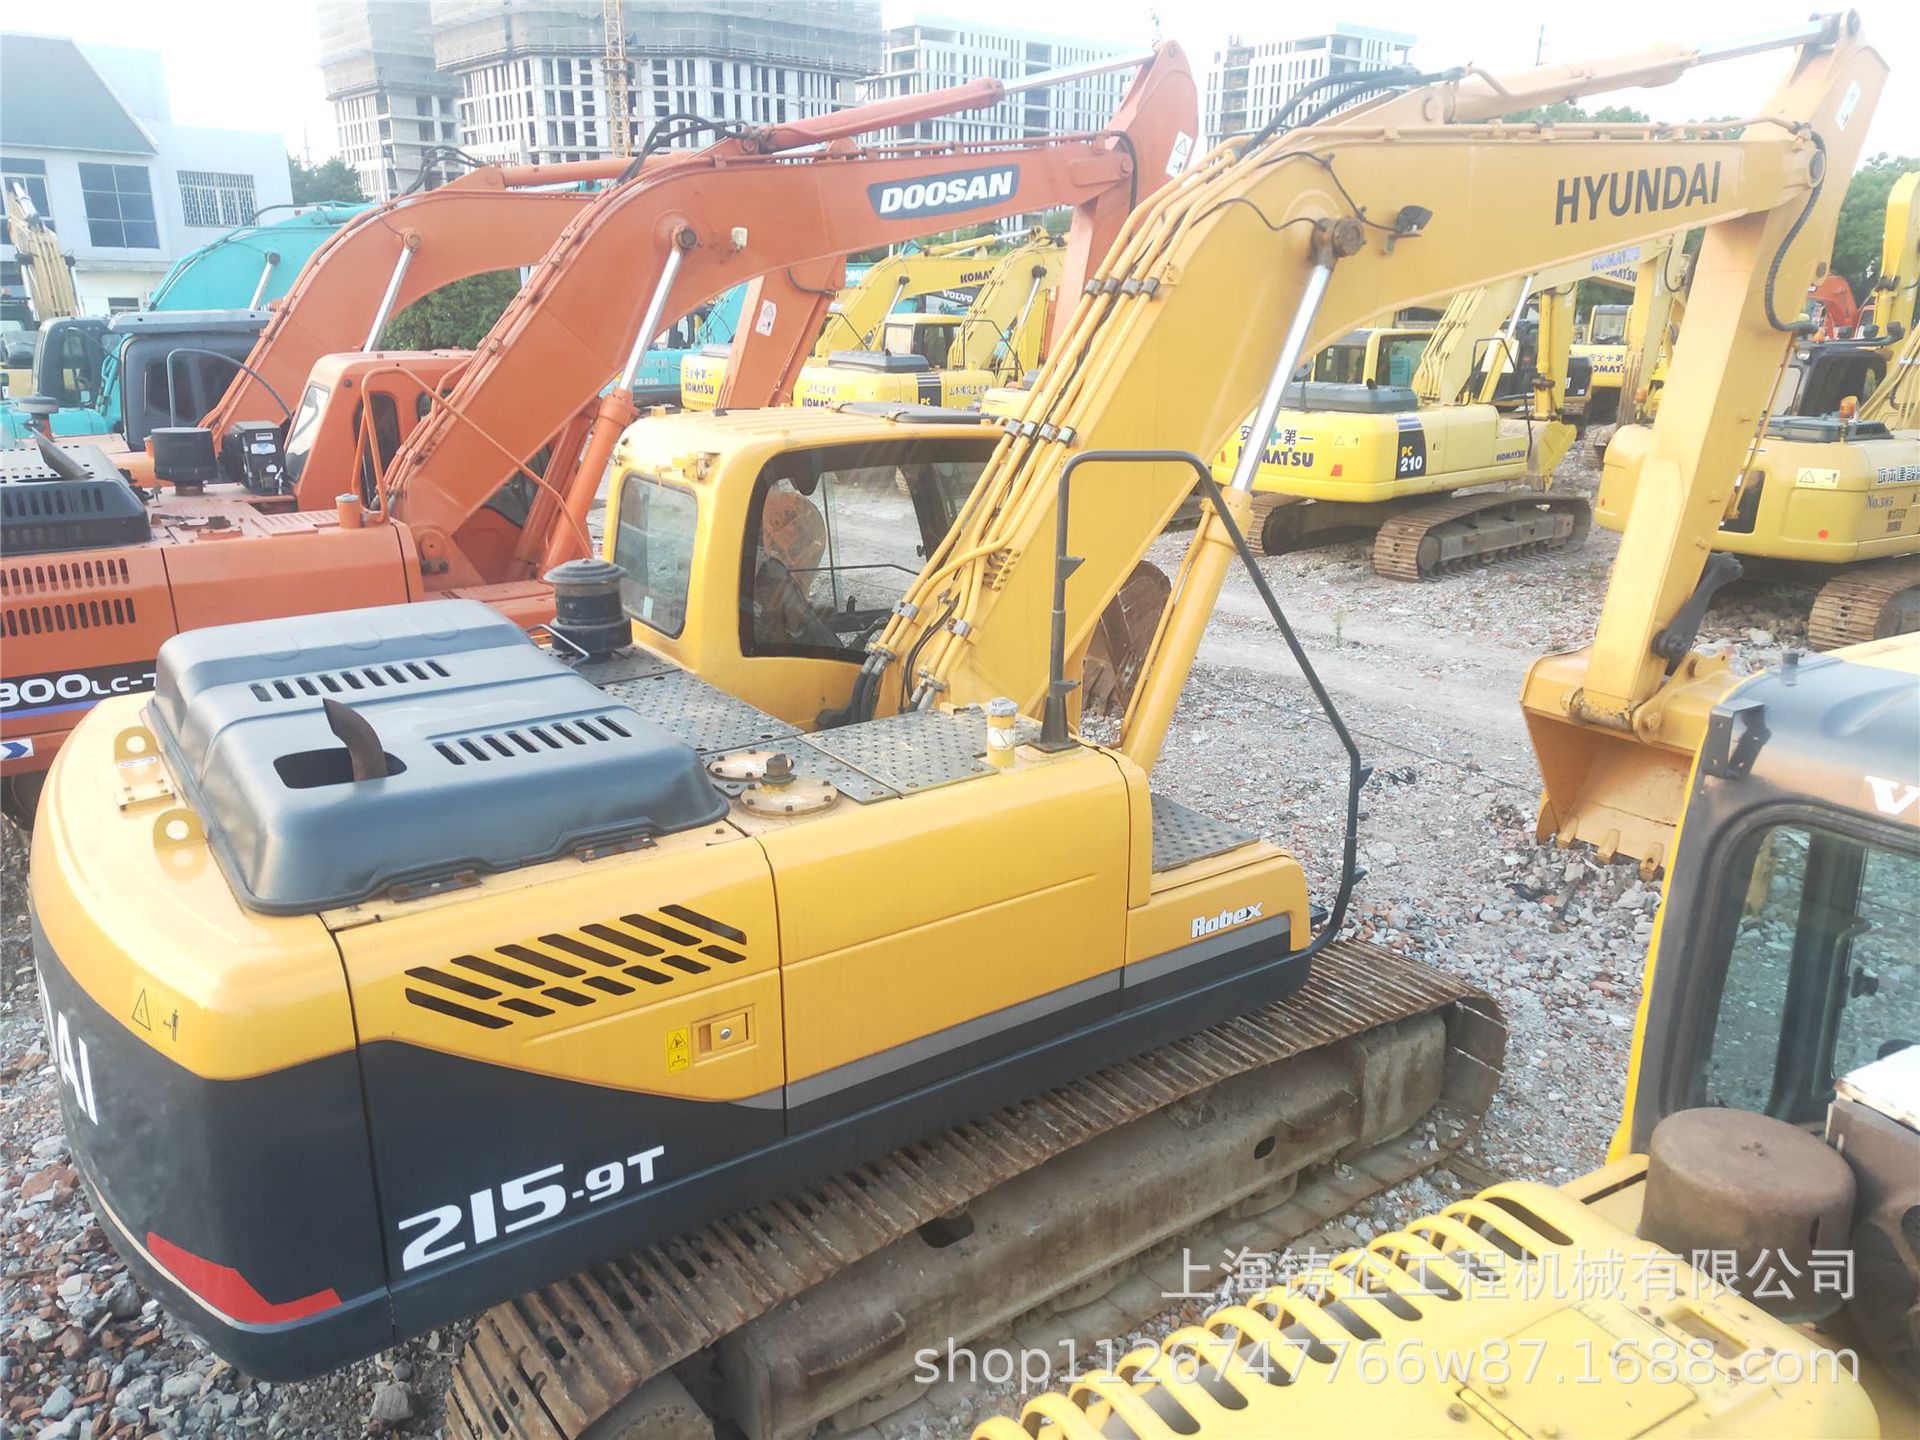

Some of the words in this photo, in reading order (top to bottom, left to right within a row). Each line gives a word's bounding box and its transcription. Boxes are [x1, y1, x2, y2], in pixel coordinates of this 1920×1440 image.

[879, 171, 1013, 214] DOOSAN
[1555, 160, 1722, 226] HYUNDAI
[942, 289, 973, 302] VOLVO
[1400, 456, 1423, 472] 210
[1401, 446, 1413, 457] PC
[1191, 902, 1264, 939] Robex
[398, 1145, 665, 1272] 215-9T
